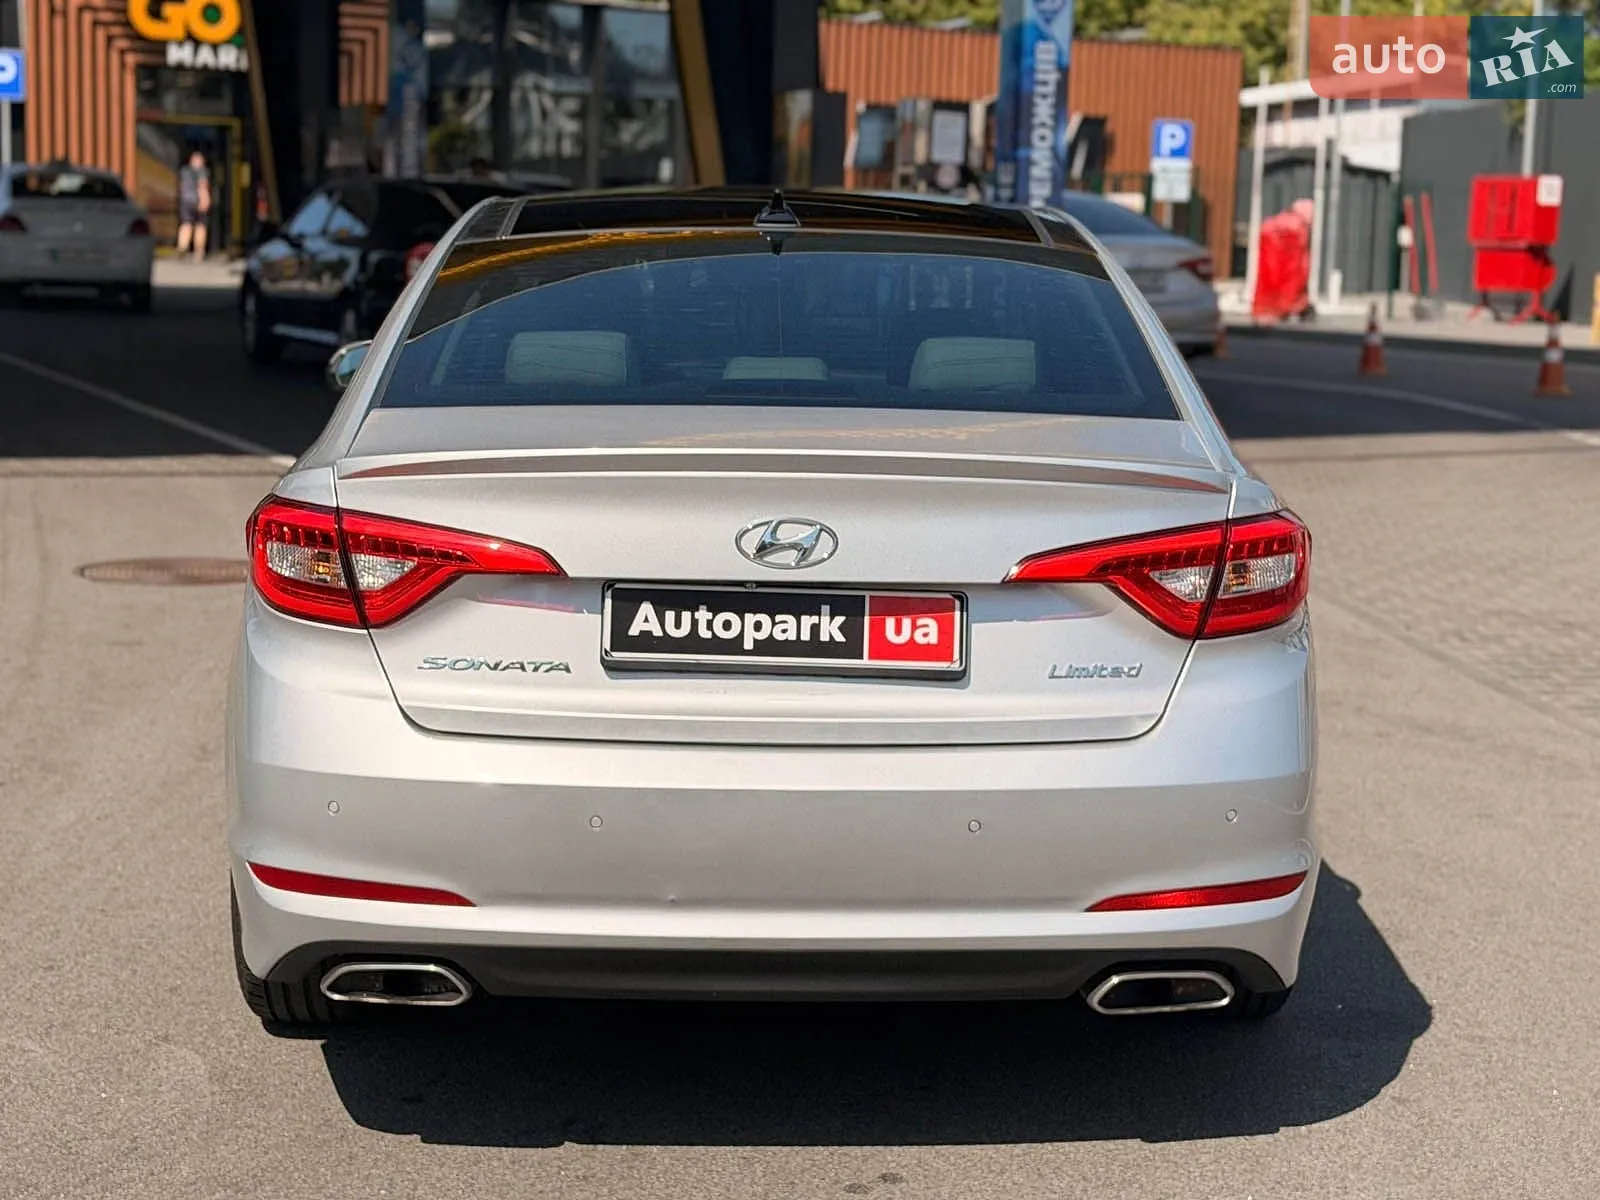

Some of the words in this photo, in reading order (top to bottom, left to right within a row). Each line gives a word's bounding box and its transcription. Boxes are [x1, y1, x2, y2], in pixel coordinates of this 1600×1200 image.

[1160, 123, 1186, 157] P
[627, 601, 847, 650] Autopark
[885, 616, 939, 646] ua
[417, 656, 572, 674] SONATA
[1048, 663, 1142, 679] Limited
